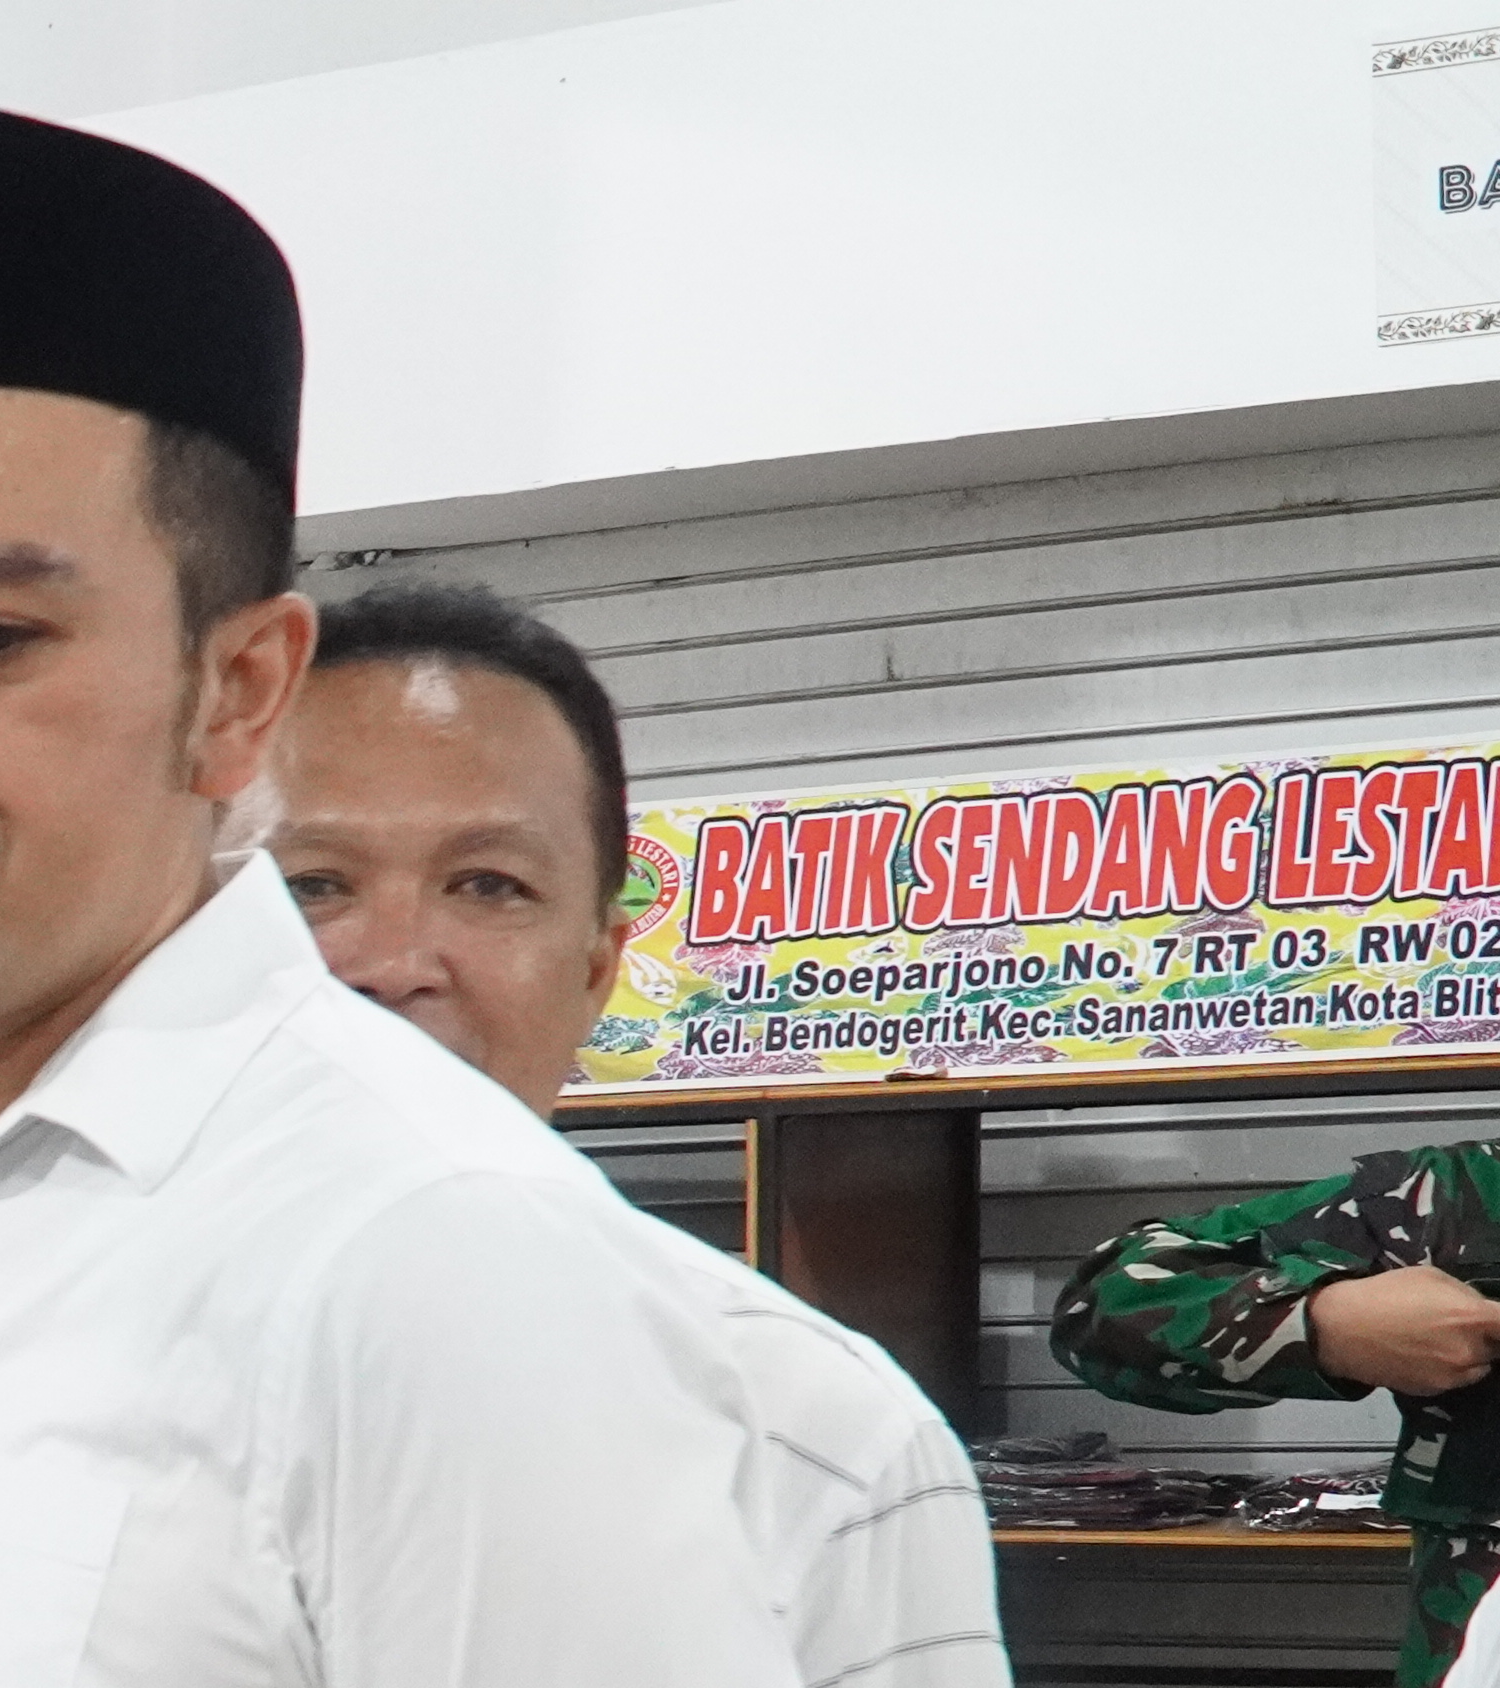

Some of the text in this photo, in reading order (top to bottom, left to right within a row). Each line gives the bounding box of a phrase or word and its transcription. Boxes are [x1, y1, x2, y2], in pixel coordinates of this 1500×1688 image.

[636, 838, 679, 888] LESTARI
[690, 803, 909, 946] BATIK
[902, 773, 1265, 934] SENDANG
[727, 918, 1500, 1001] Jl. Soeparjono No. 7 RT 03 RW 02
[684, 977, 1500, 1056] Kel. Bendogerit Kec. Sananwetan Kota Blit
